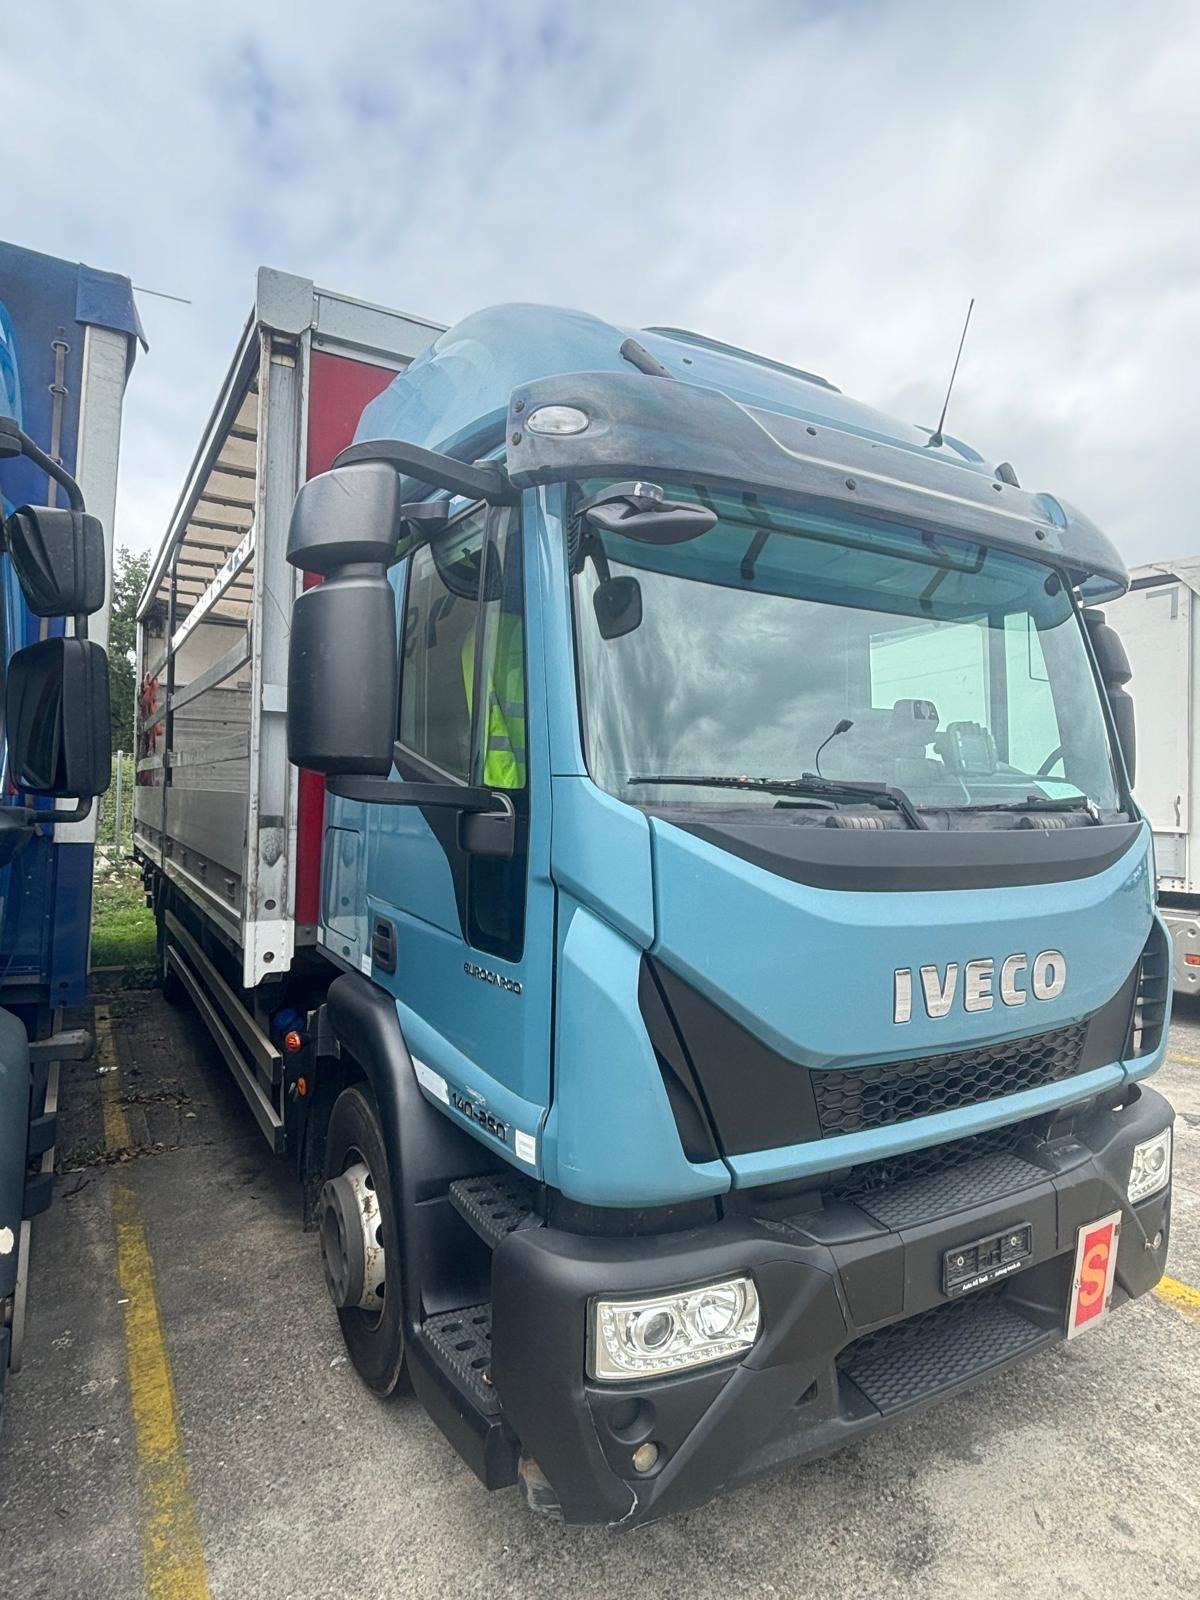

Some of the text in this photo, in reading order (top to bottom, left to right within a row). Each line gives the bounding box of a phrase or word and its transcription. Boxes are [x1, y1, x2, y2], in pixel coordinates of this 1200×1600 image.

[463, 961, 523, 996] EUROCARGO
[893, 948, 1067, 1025] IVECO
[1079, 1243, 1109, 1308] S
